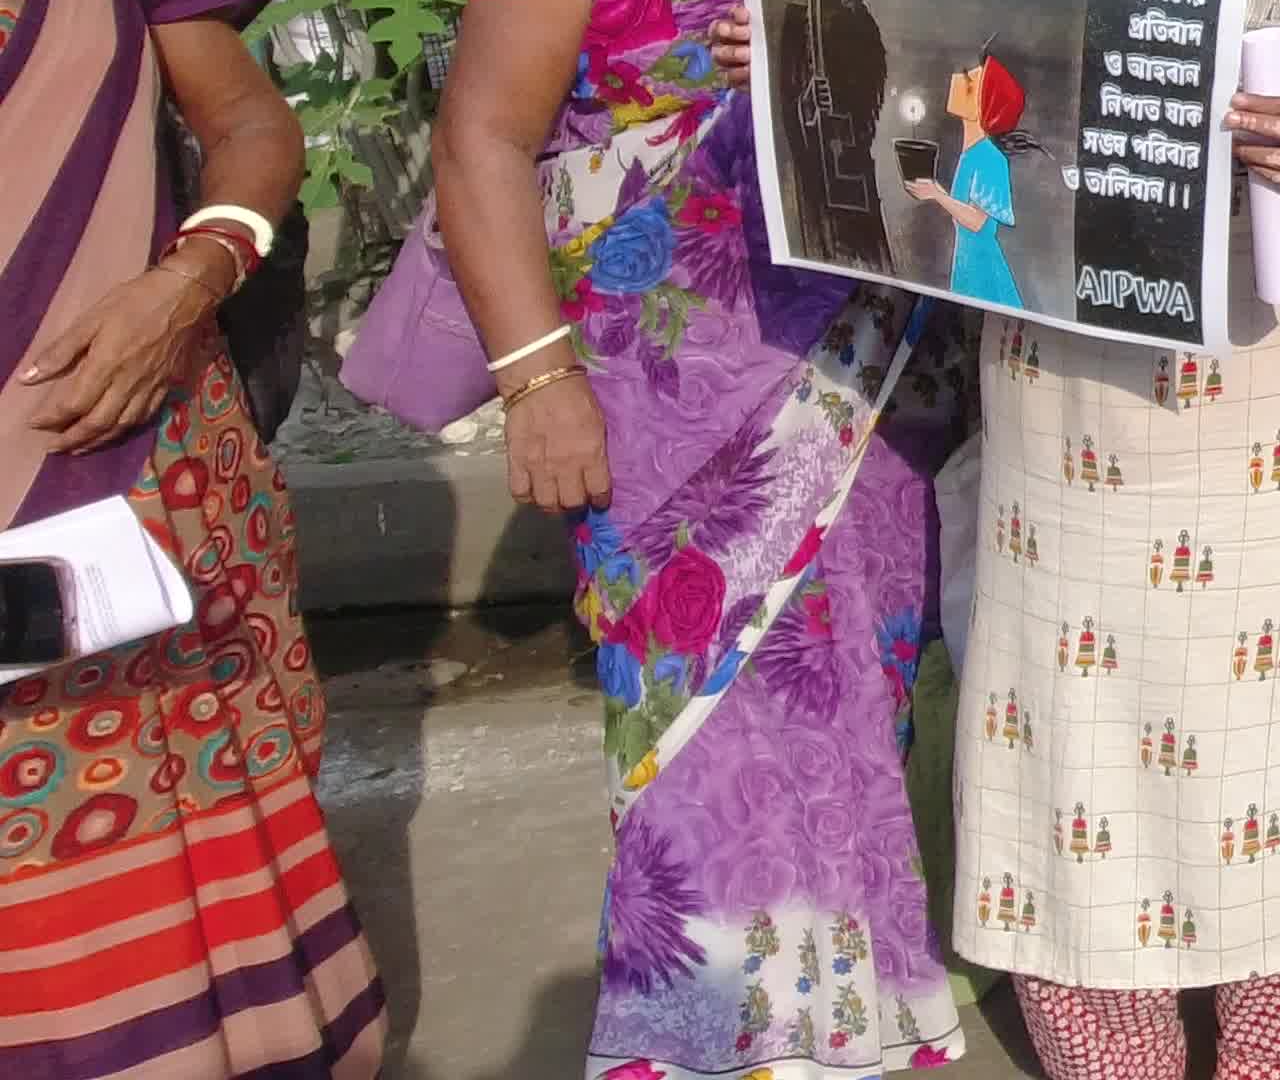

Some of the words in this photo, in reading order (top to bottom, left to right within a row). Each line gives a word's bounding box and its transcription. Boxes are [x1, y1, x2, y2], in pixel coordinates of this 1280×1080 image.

[1128, 7, 1204, 47] প্রতিবাদ
[1103, 51, 1123, 77] ও
[1100, 82, 1161, 122] নিপাত
[1131, 129, 1201, 170] পরিবার
[1061, 165, 1081, 191] ও
[1076, 265, 1195, 322] AIPWA
